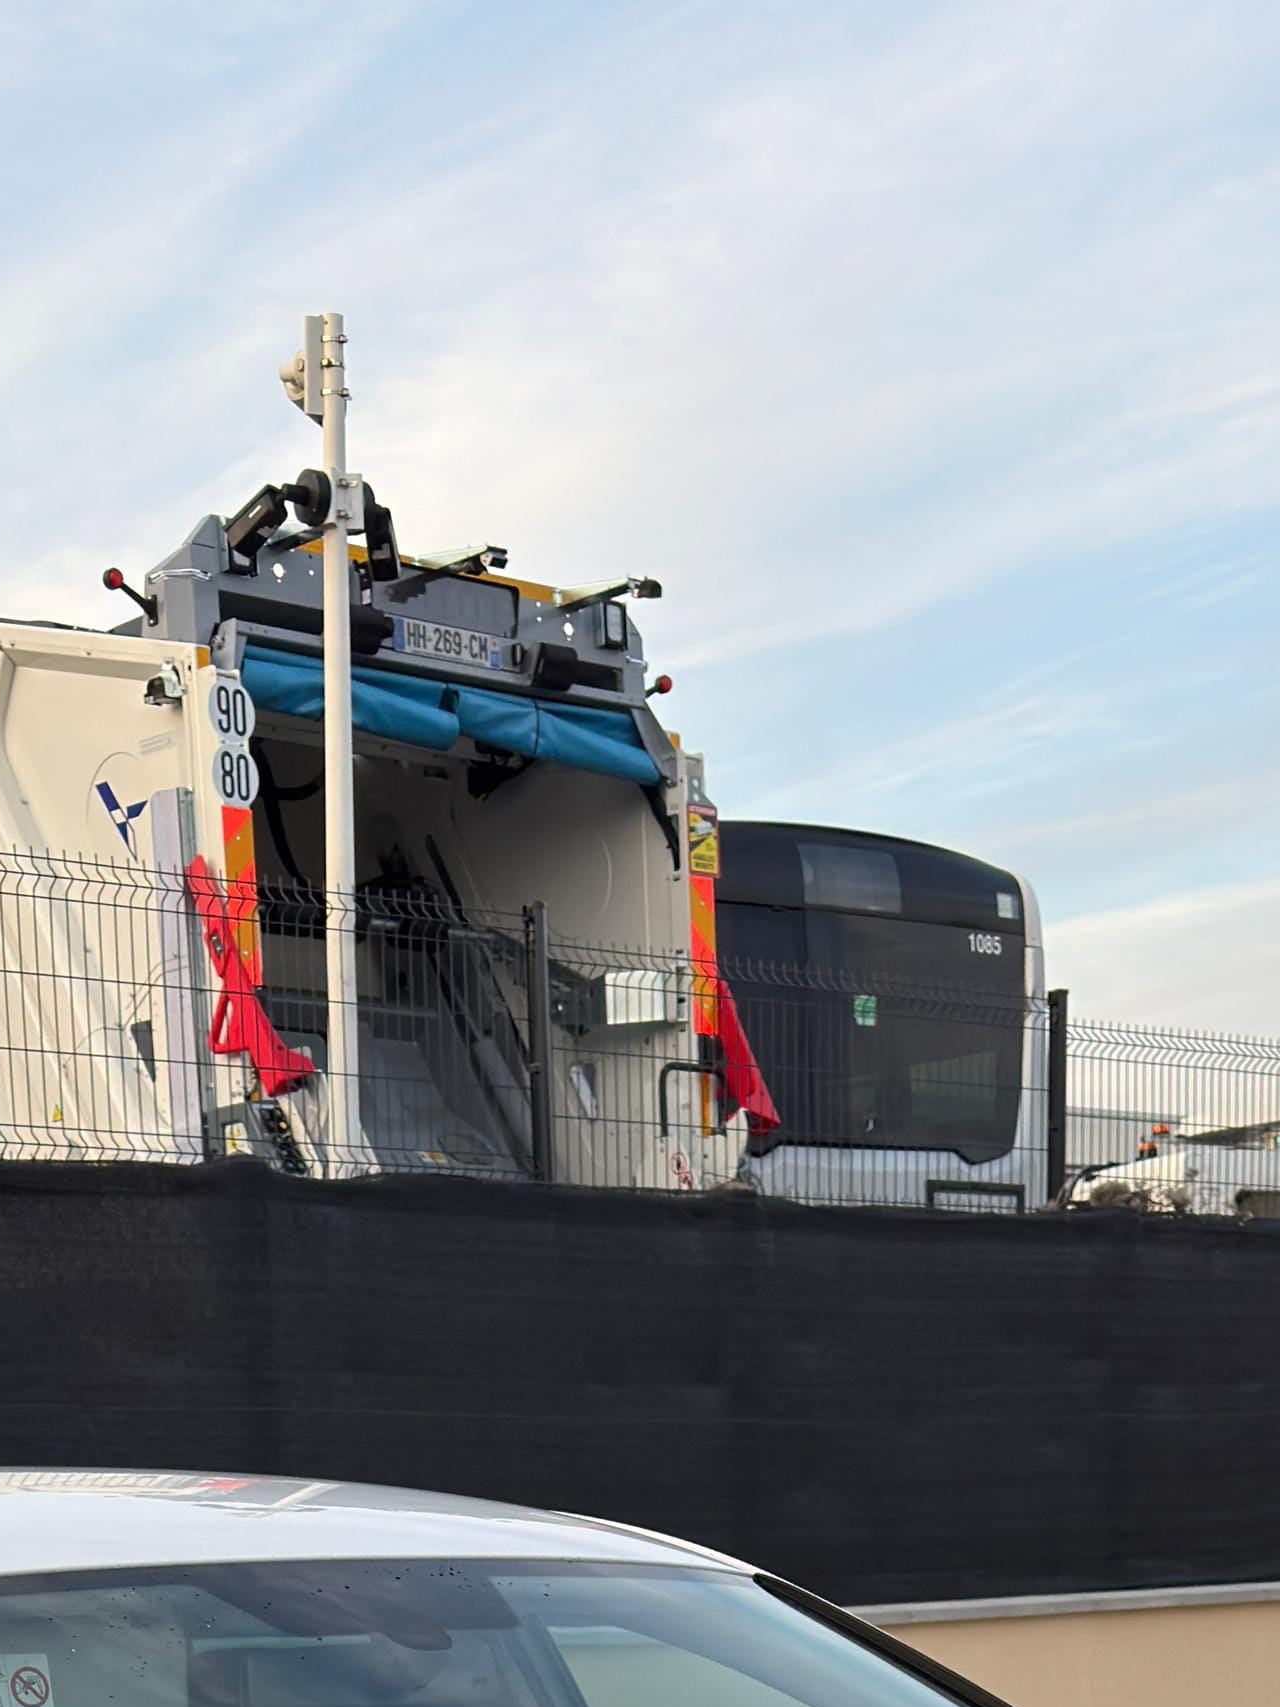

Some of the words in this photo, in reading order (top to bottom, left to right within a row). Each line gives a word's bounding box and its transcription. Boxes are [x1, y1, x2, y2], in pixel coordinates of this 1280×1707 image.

[217, 685, 246, 737] 90
[221, 750, 250, 801] 80
[967, 932, 1002, 956] 1085
